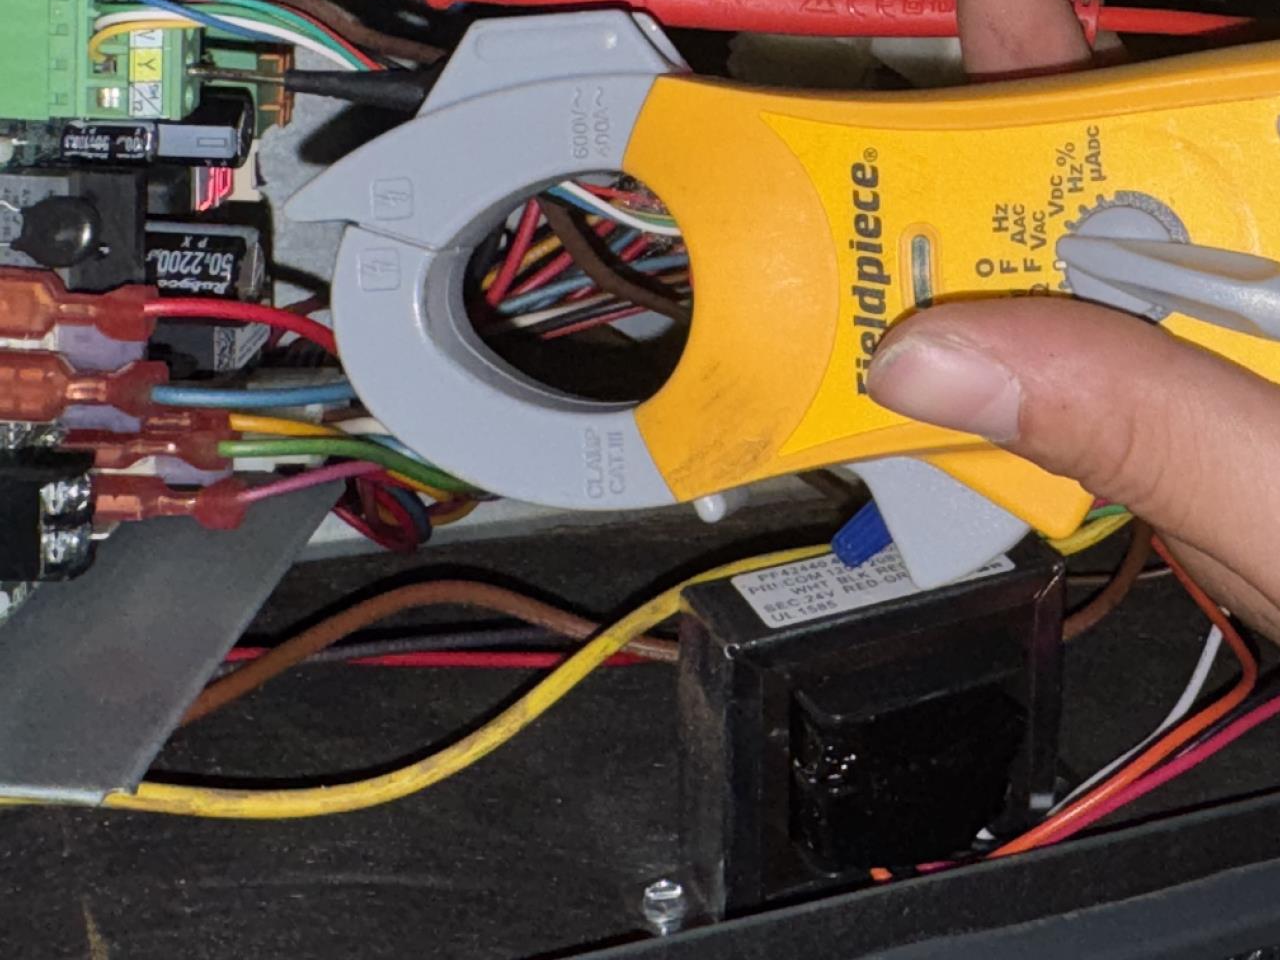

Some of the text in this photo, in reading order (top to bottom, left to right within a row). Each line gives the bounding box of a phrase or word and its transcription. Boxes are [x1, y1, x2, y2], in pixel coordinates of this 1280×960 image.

[137, 57, 156, 71] Y
[1064, 162, 1084, 193] Hz
[991, 202, 1009, 233] Hz
